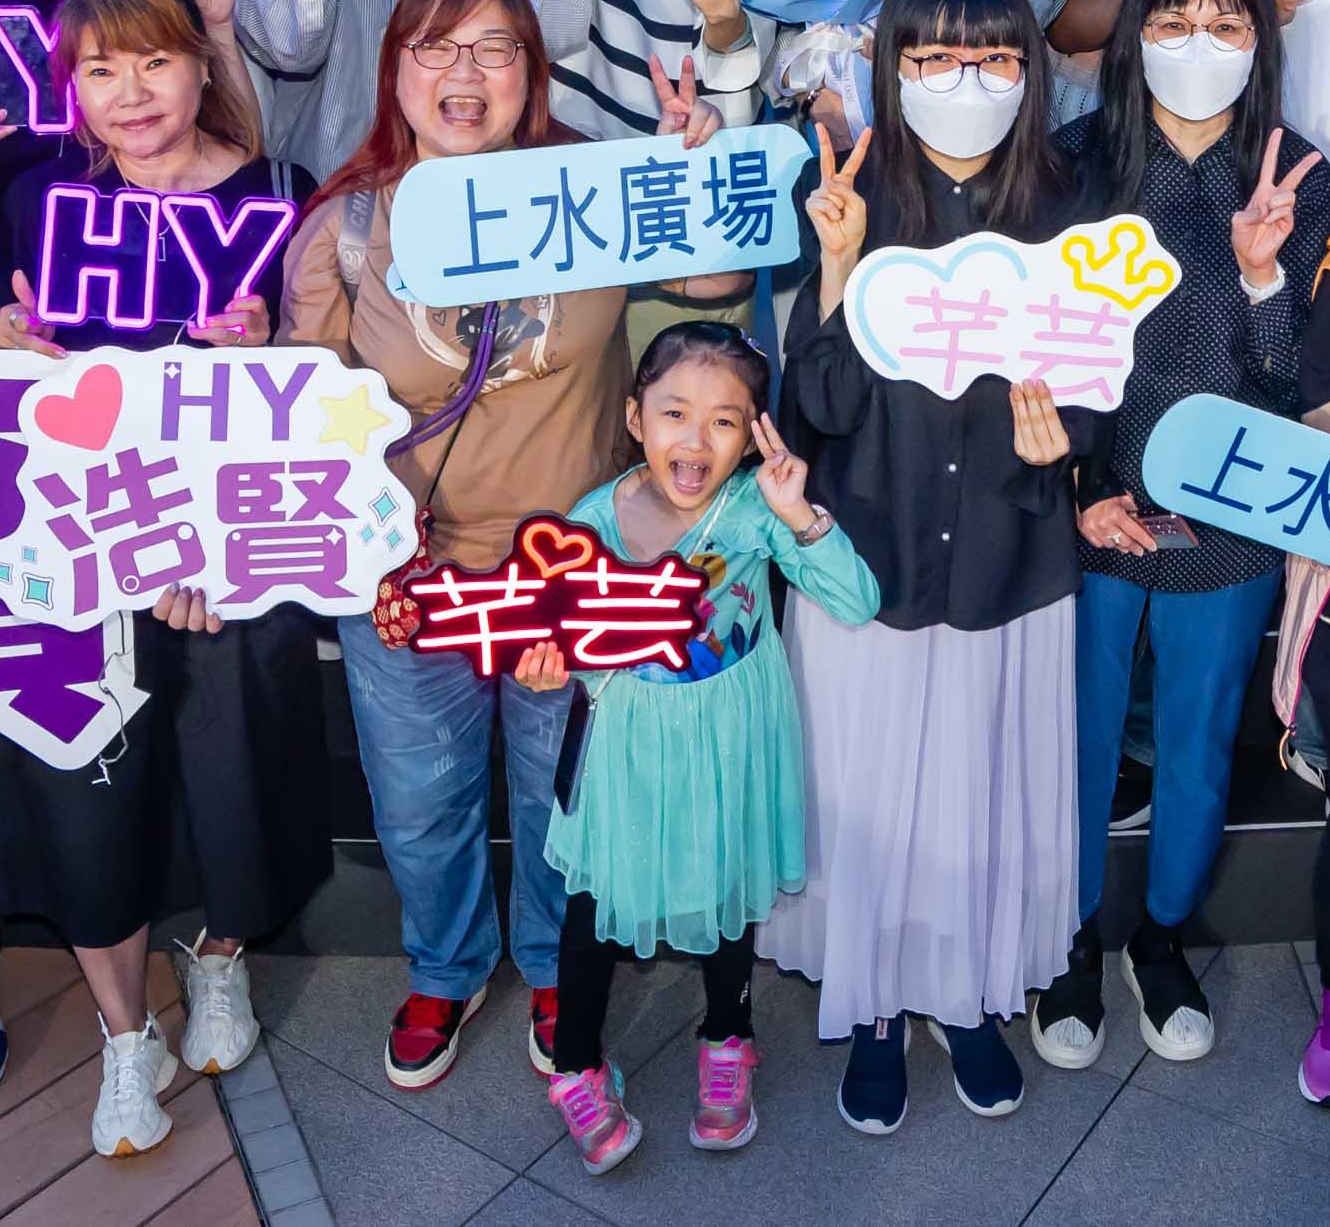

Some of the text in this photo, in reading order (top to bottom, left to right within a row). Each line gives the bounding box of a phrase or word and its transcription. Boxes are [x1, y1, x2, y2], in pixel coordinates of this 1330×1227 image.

[36, 184, 296, 330] HY
[442, 150, 778, 278] 上水廣場
[160, 361, 318, 442] HY
[32, 447, 361, 617] 浩賢
